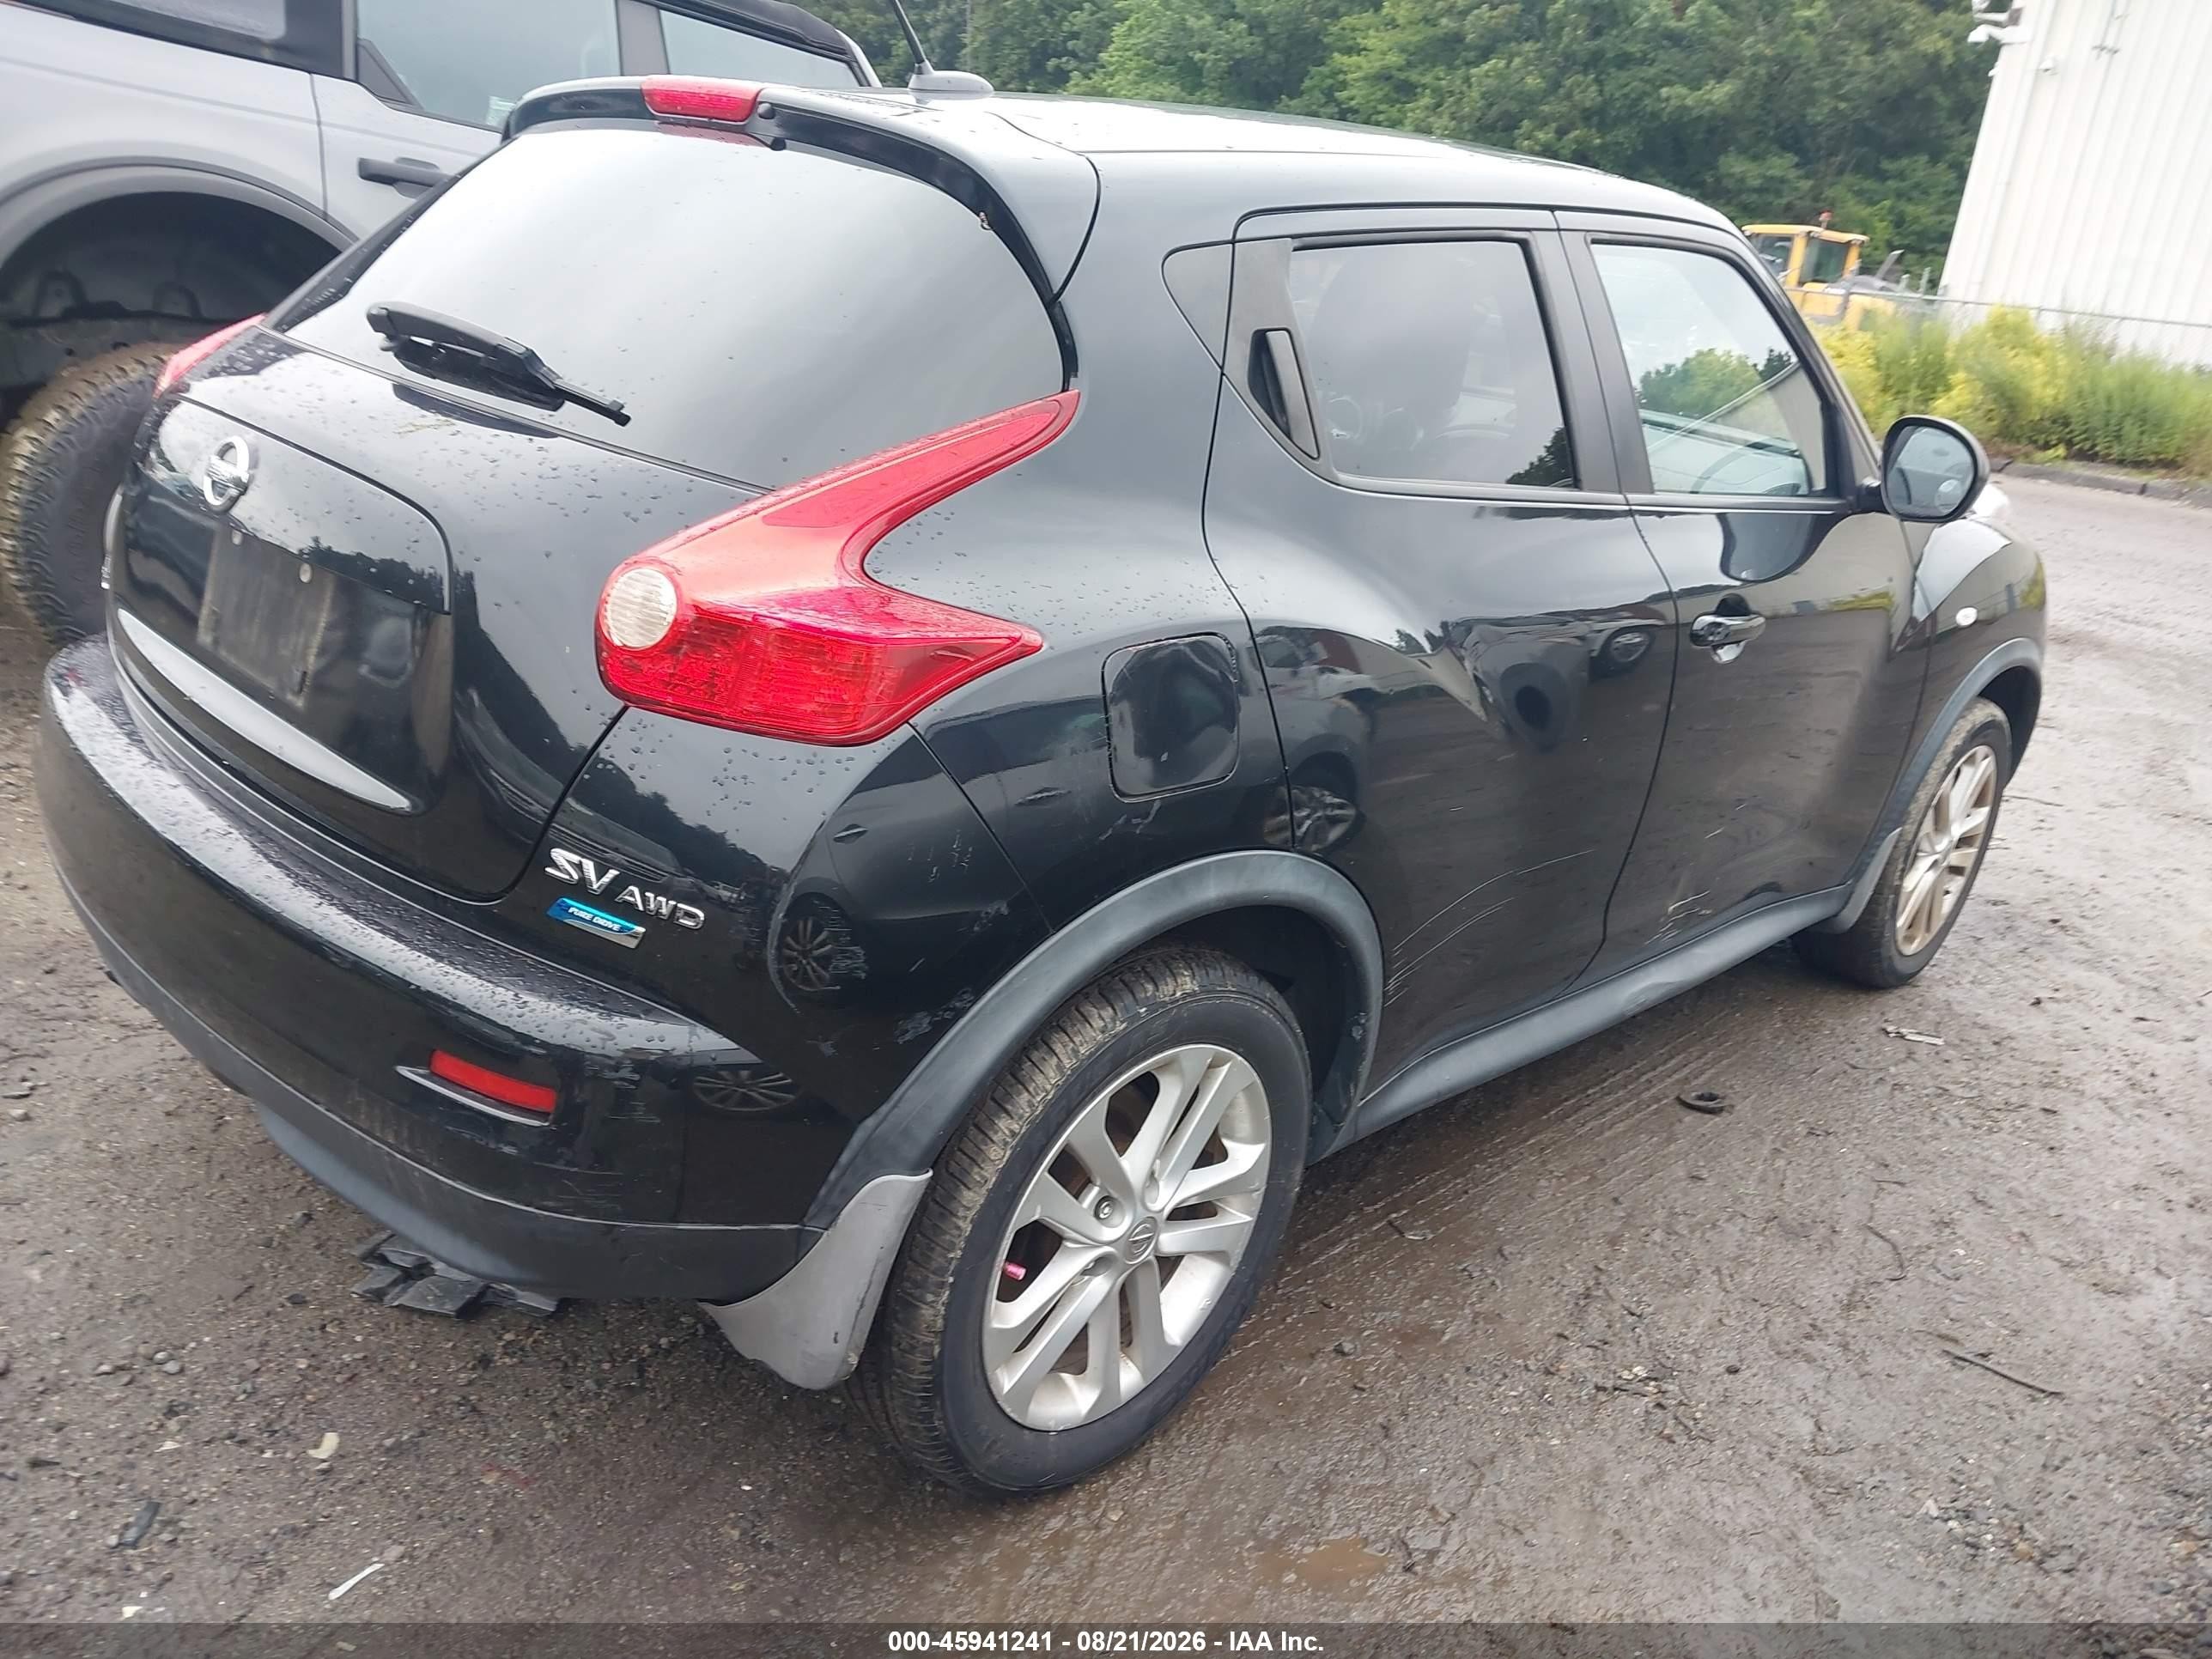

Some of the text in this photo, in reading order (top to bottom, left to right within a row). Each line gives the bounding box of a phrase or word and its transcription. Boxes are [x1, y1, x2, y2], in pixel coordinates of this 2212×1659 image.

[544, 847, 706, 930] SV AWD
[568, 907, 622, 932] PURE DRIVE
